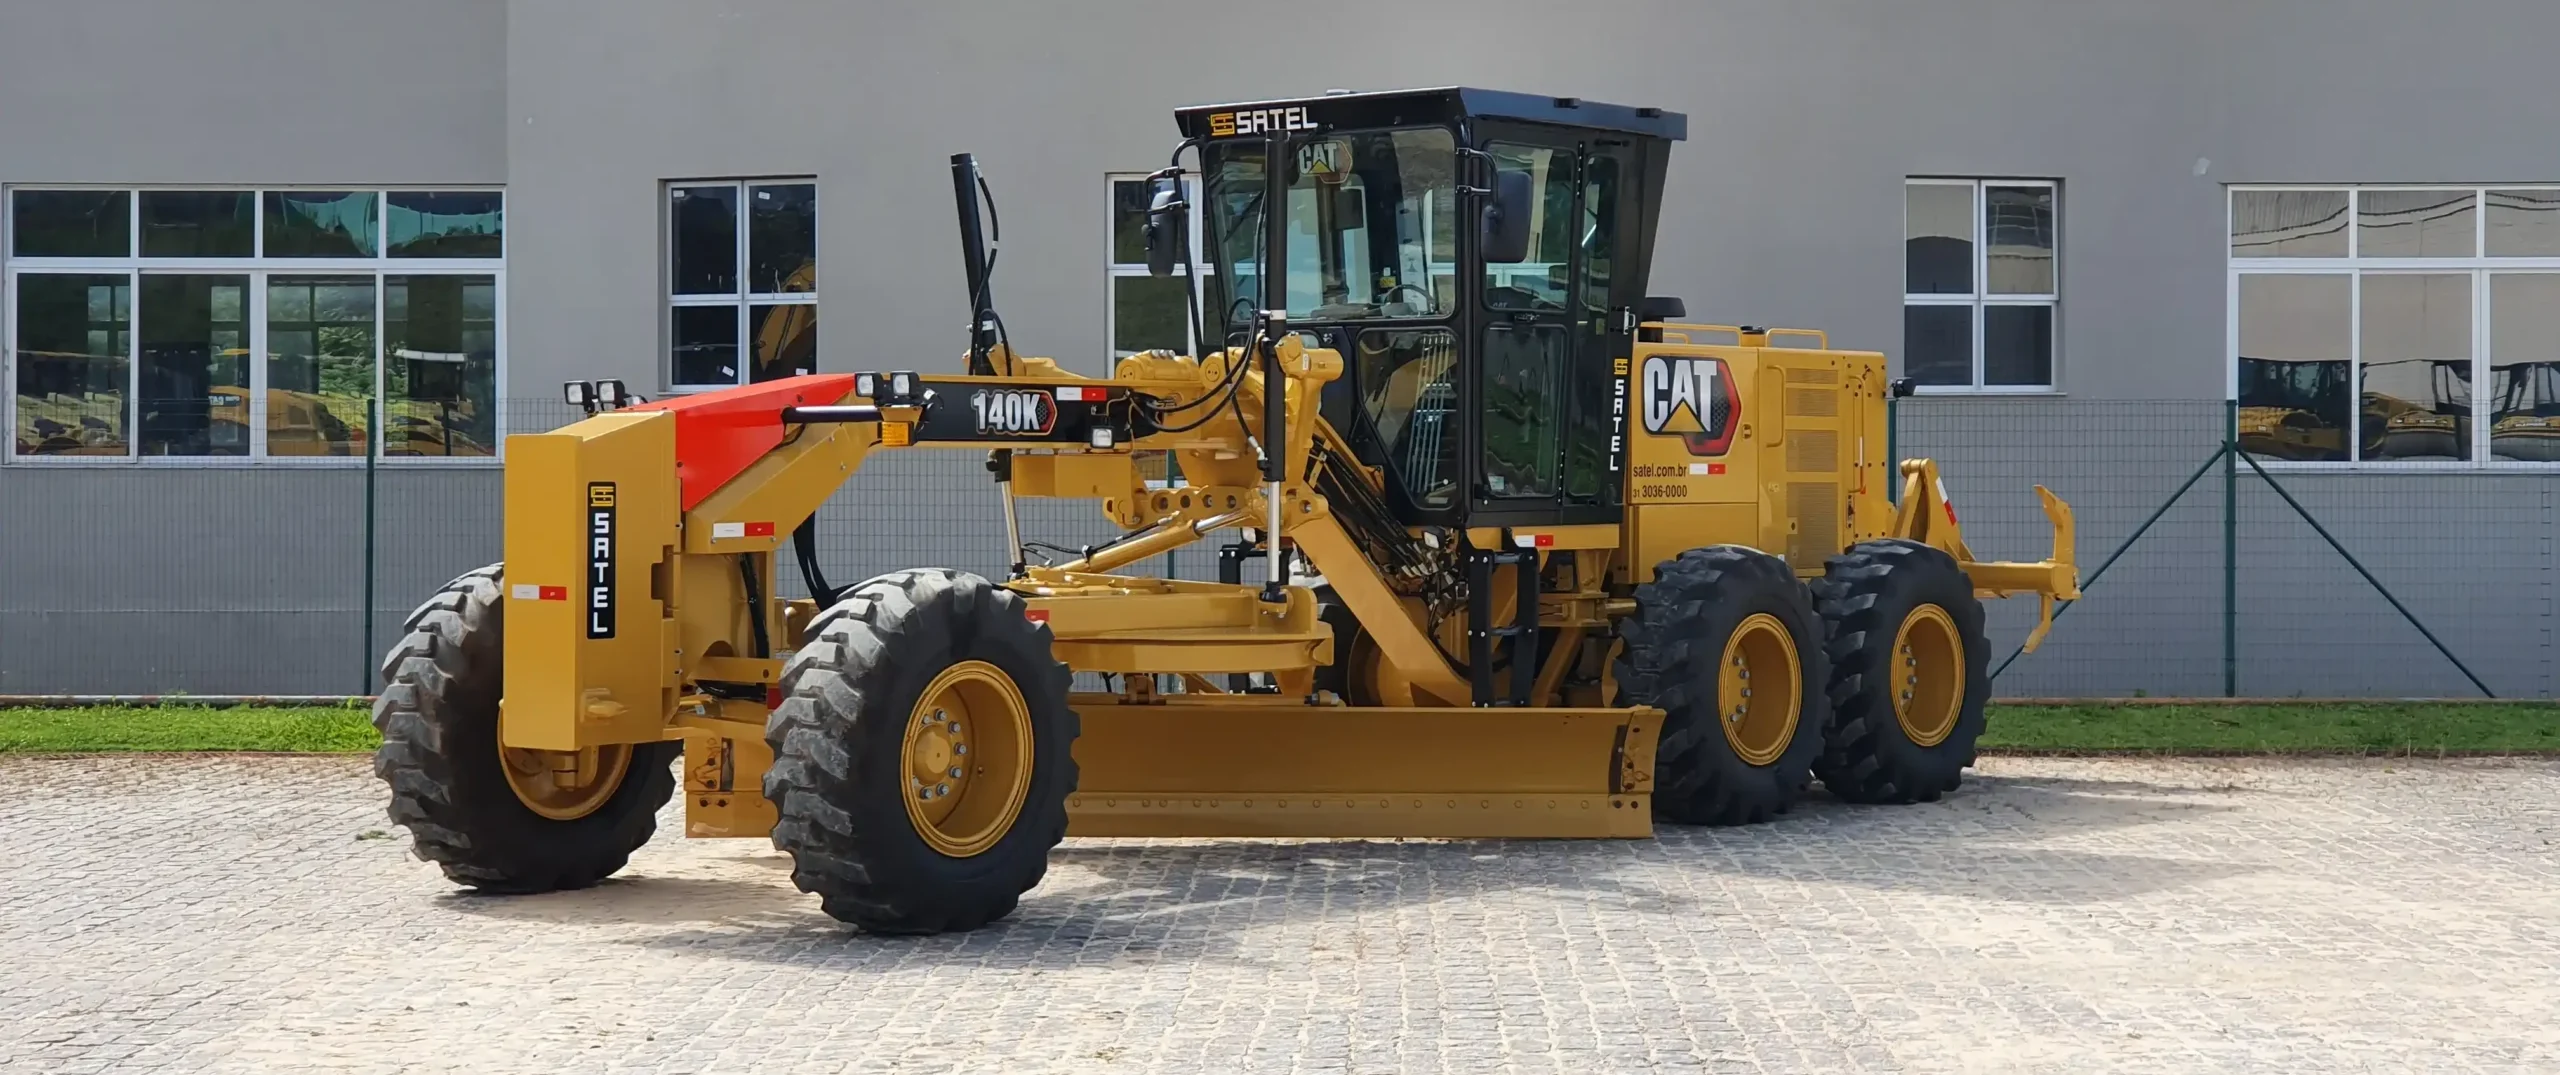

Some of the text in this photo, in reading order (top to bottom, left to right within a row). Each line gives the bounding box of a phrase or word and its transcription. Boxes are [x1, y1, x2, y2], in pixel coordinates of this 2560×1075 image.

[1236, 106, 1318, 134] SATEL
[1299, 142, 1337, 174] CAT
[973, 392, 1041, 431] 140K
[1643, 357, 1717, 433] CAT
[1610, 379, 1625, 471] SATEL
[1633, 463, 1687, 478] satel.com.br
[1633, 484, 1688, 498] 31 3036-0000
[593, 512, 610, 633] SATEL
